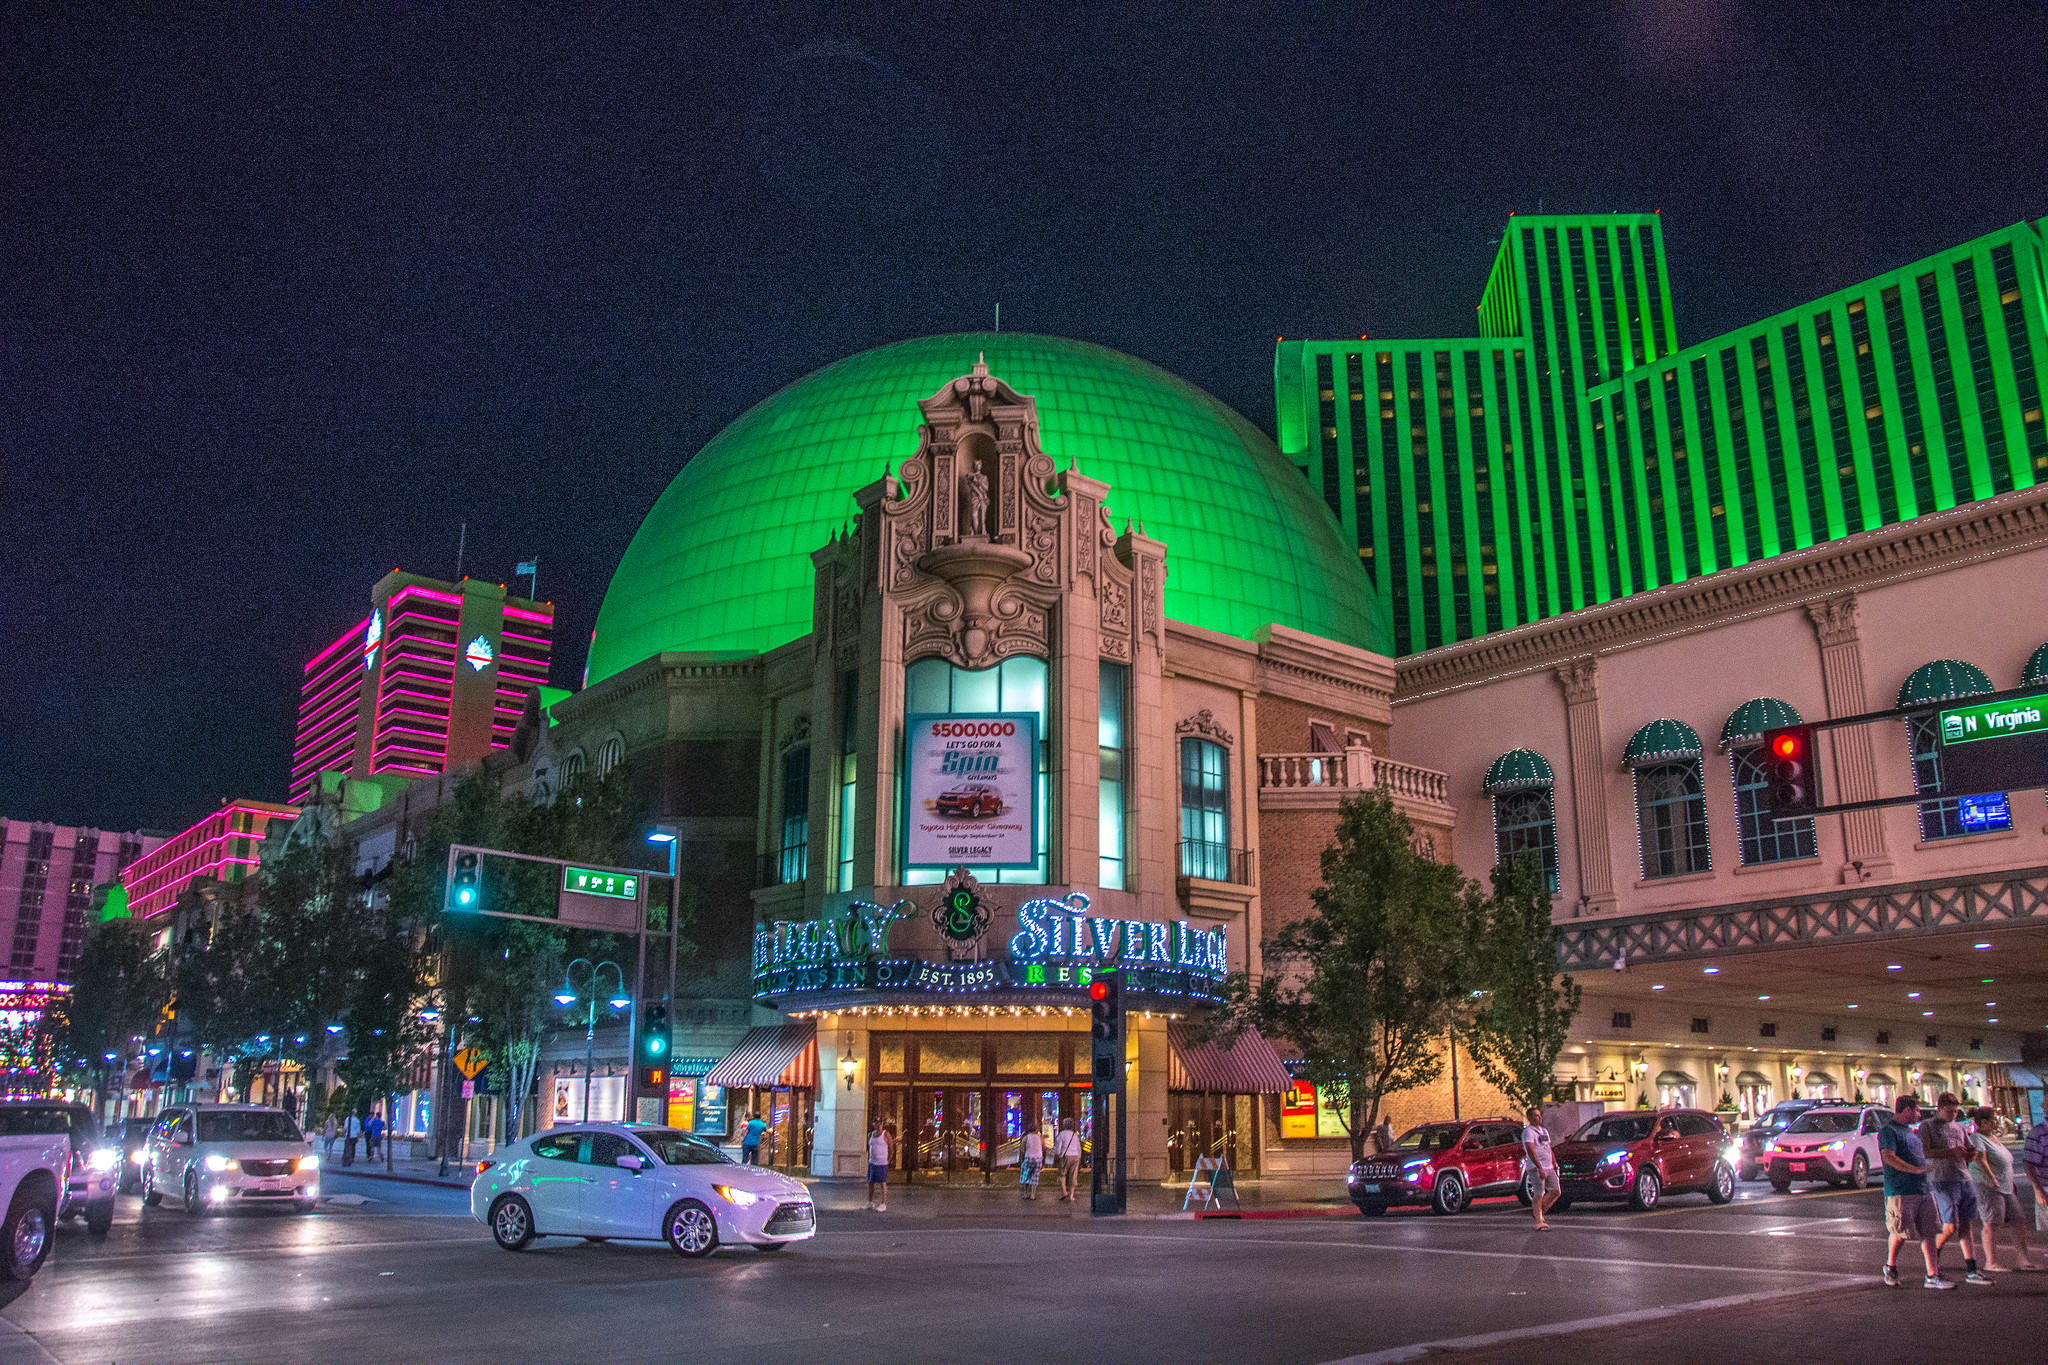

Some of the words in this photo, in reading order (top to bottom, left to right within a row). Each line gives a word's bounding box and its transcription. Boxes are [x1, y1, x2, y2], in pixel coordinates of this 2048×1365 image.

[1965, 715, 1978, 732] N
[1984, 706, 2041, 731] Virginia
[931, 722, 1016, 739] $500,000
[946, 741, 966, 749] LET'S
[967, 741, 979, 749] GO
[980, 741, 995, 749] FOR
[941, 750, 999, 779] Spin
[919, 823, 945, 832] Toyota
[946, 823, 985, 832] Highlander
[987, 823, 1023, 832] Giveaway
[948, 846, 968, 855] SILVER
[969, 846, 993, 855] LEGACY
[578, 875, 587, 887] W
[773, 899, 918, 962] LEGACY
[1009, 891, 1172, 963] SILVER
[785, 966, 893, 986] CASINO
[919, 967, 954, 986] EST.
[960, 968, 994, 986] 1895
[1028, 966, 1161, 988] RESRT
